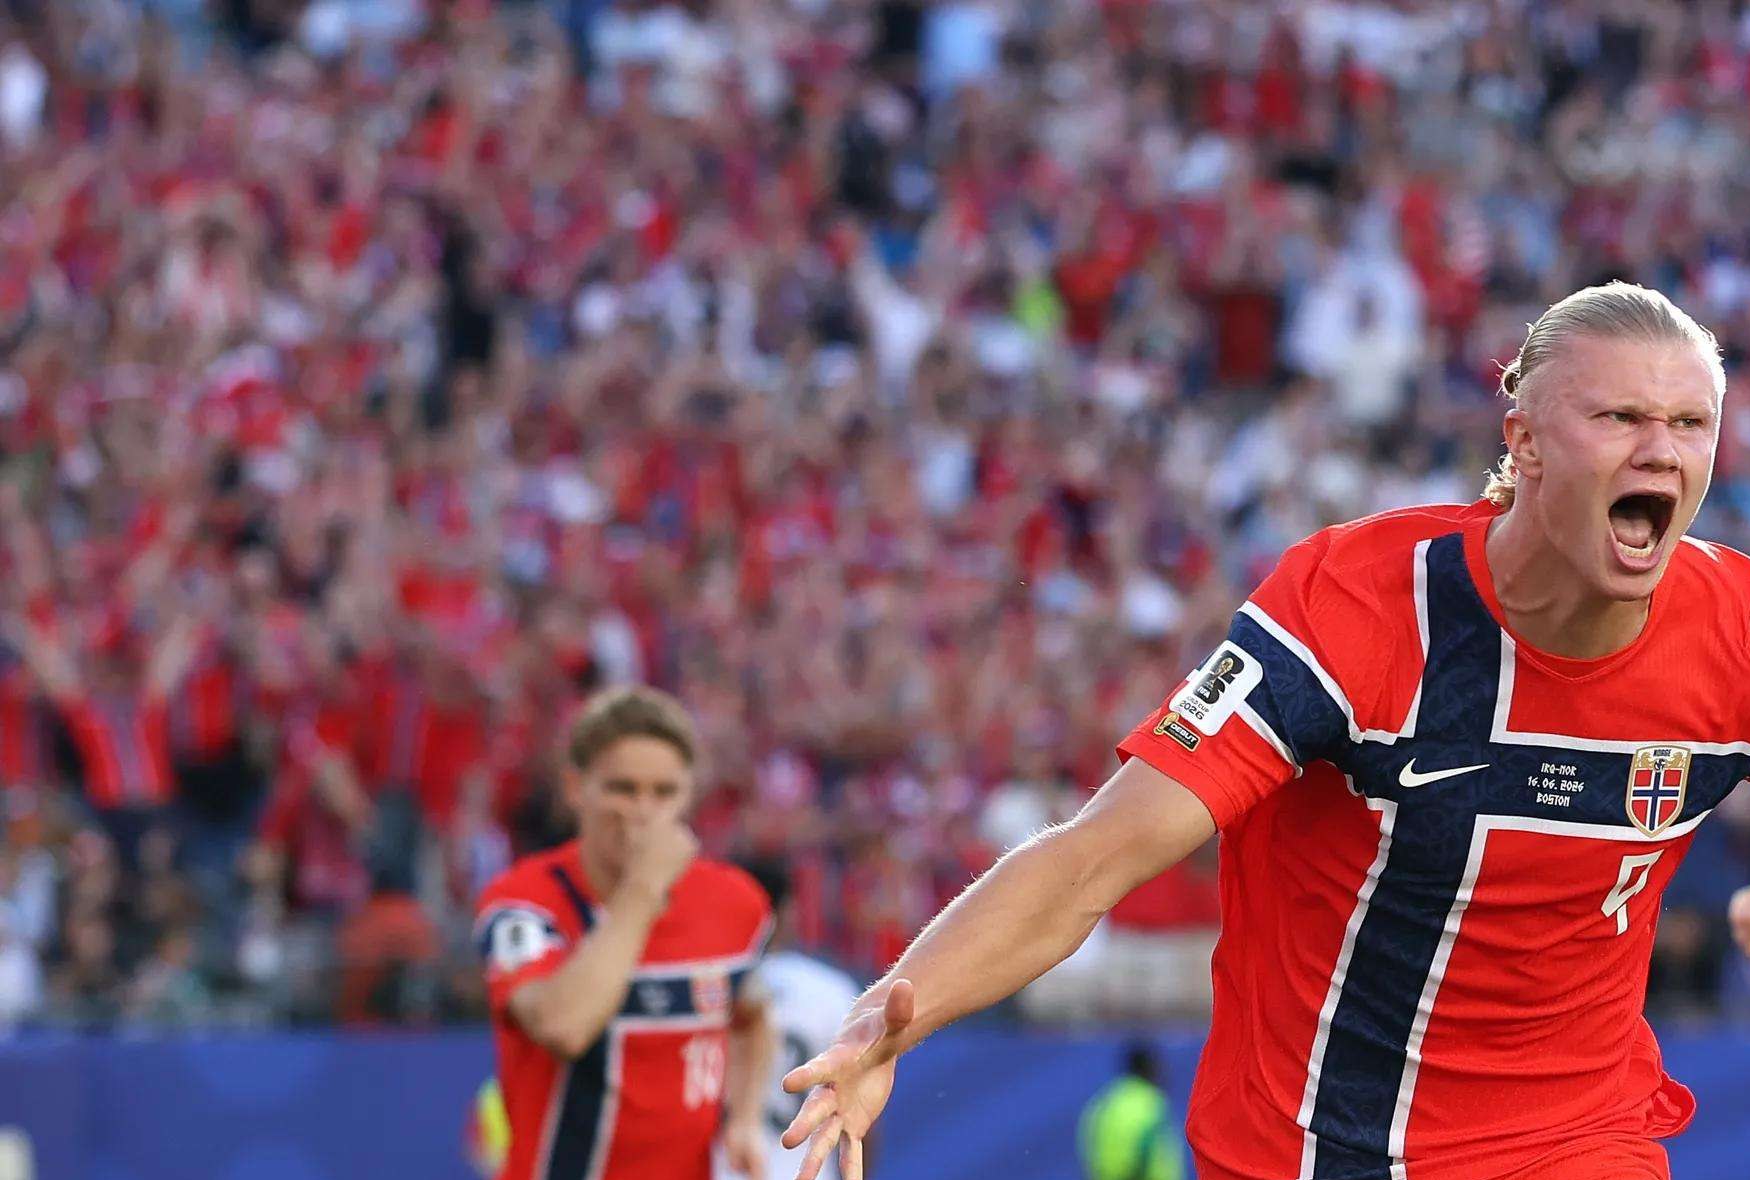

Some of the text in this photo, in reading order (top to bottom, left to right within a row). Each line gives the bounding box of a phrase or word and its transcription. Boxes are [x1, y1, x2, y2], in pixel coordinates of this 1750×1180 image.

[1179, 700, 1205, 720] 2026
[1170, 723, 1197, 743] DEBUT
[1536, 792, 1571, 807] BOSTON
[1601, 849, 1664, 936] 9
